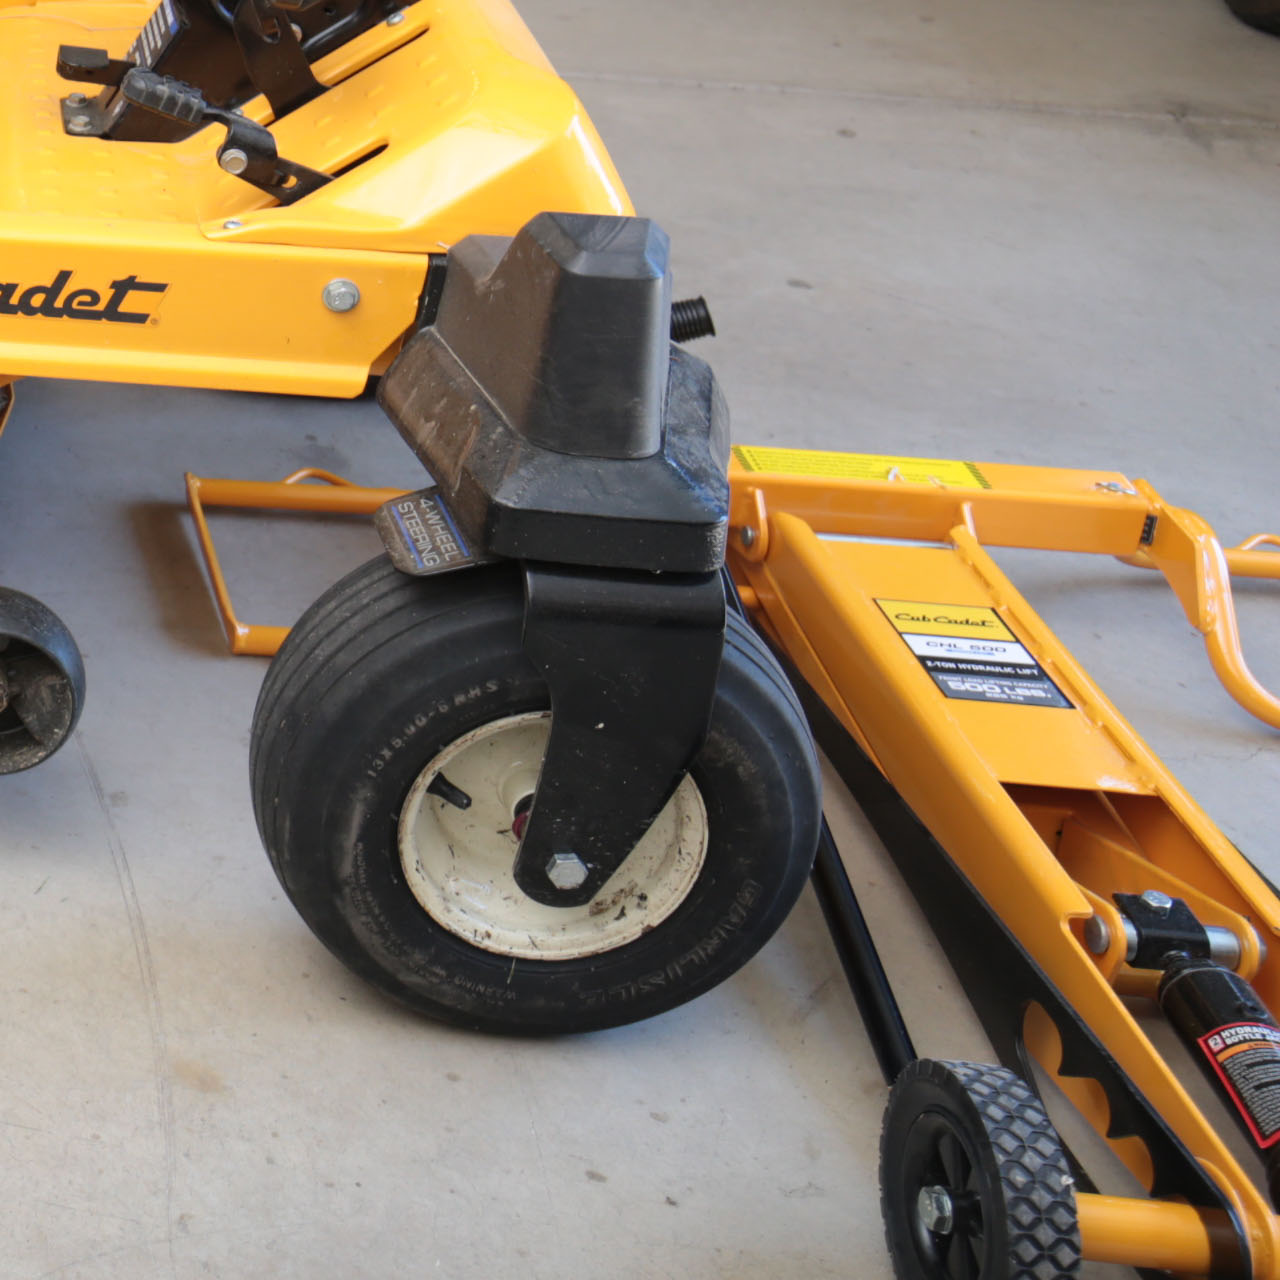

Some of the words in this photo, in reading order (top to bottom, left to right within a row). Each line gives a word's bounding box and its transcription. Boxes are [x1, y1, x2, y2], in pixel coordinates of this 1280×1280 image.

[398, 501, 440, 567] STEERING
[420, 498, 459, 561] 4-WHEEL
[895, 613, 931, 622] Cub
[934, 616, 995, 628] Cadet
[926, 641, 963, 650] CHL
[970, 645, 1007, 653] 500
[925, 660, 956, 670] 2-TON
[958, 662, 1015, 674] HYDRAULIC
[1016, 667, 1039, 676] LIFT
[947, 680, 1002, 693] 500
[1224, 1033, 1264, 1045] BOTTLE
